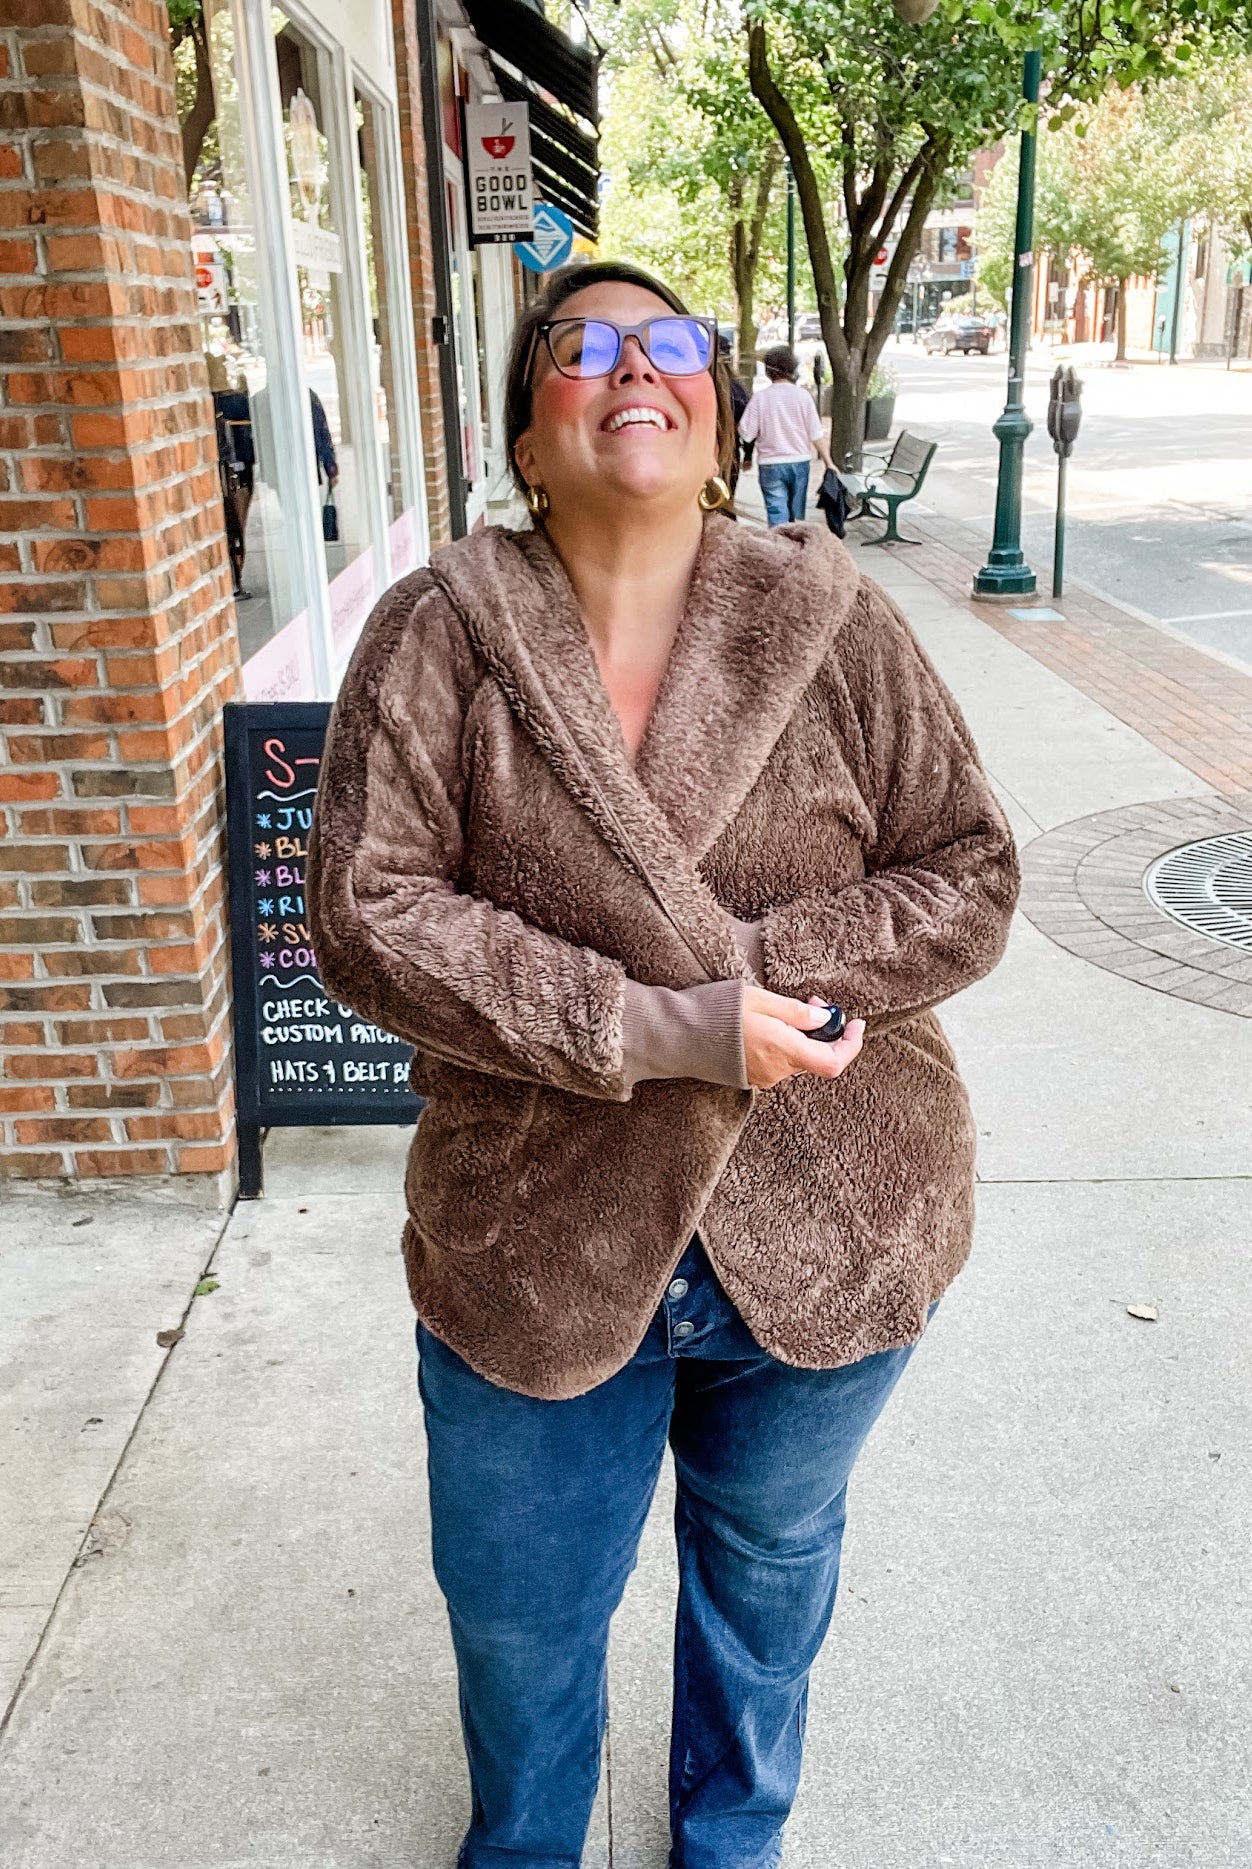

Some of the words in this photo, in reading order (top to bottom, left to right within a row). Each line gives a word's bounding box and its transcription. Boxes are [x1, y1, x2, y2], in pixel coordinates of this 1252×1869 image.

[476, 175, 526, 193] GOOD
[477, 194, 527, 211] BOWL
[262, 998, 331, 1022] CHECK
[261, 1023, 343, 1045] CUSTOM
[270, 1060, 319, 1083] HATS
[343, 1061, 390, 1083] BELT
